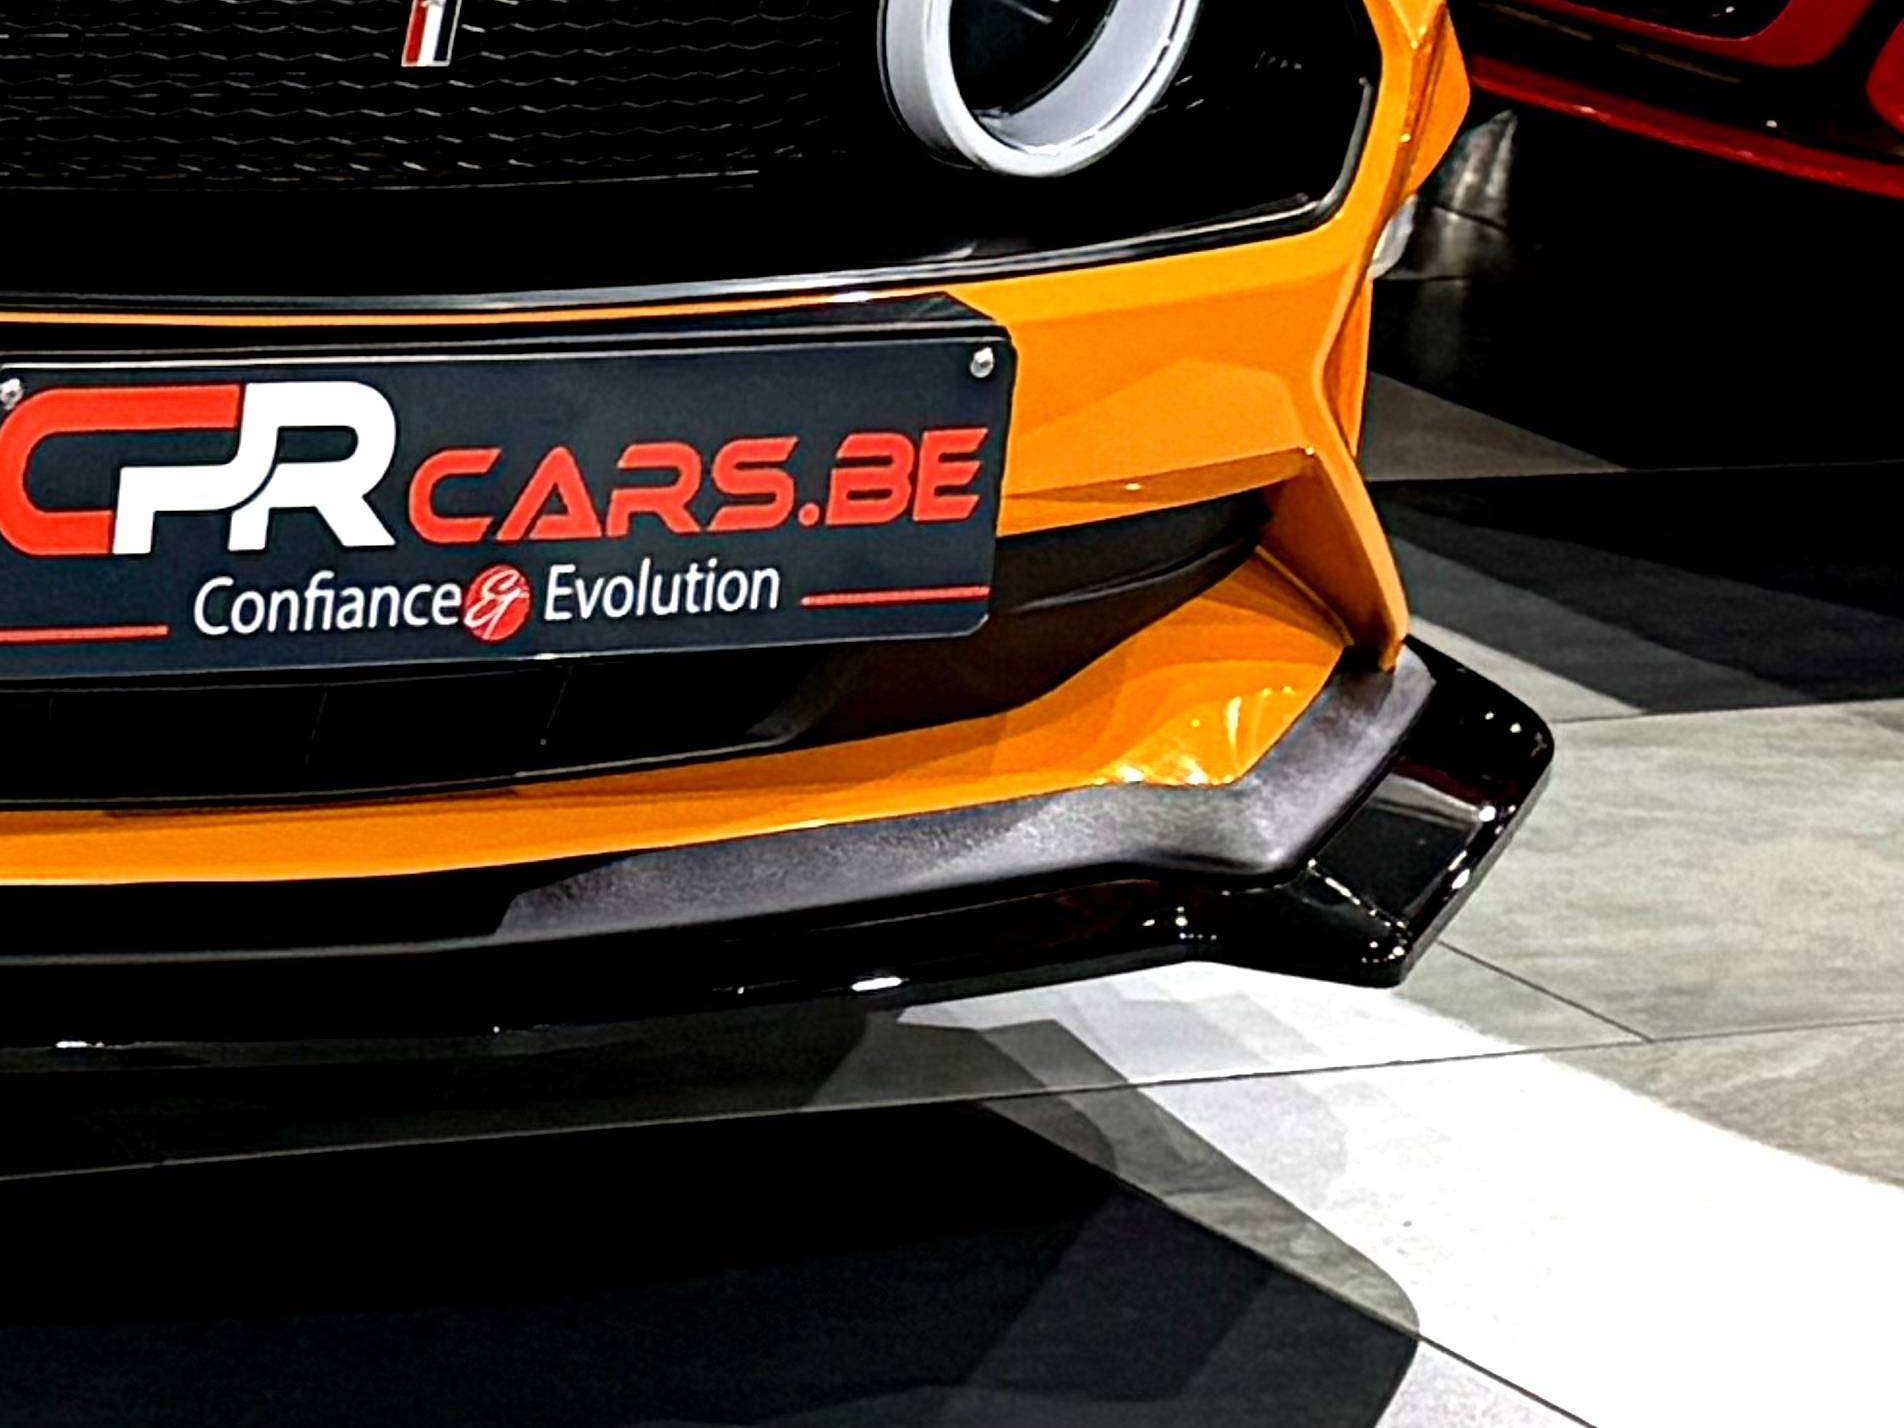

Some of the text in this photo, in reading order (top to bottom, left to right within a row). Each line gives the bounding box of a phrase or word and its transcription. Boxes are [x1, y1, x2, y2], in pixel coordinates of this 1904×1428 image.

[406, 427, 989, 543] CARS.BE
[193, 570, 461, 636] Confiance
[544, 558, 781, 622] Evolution
